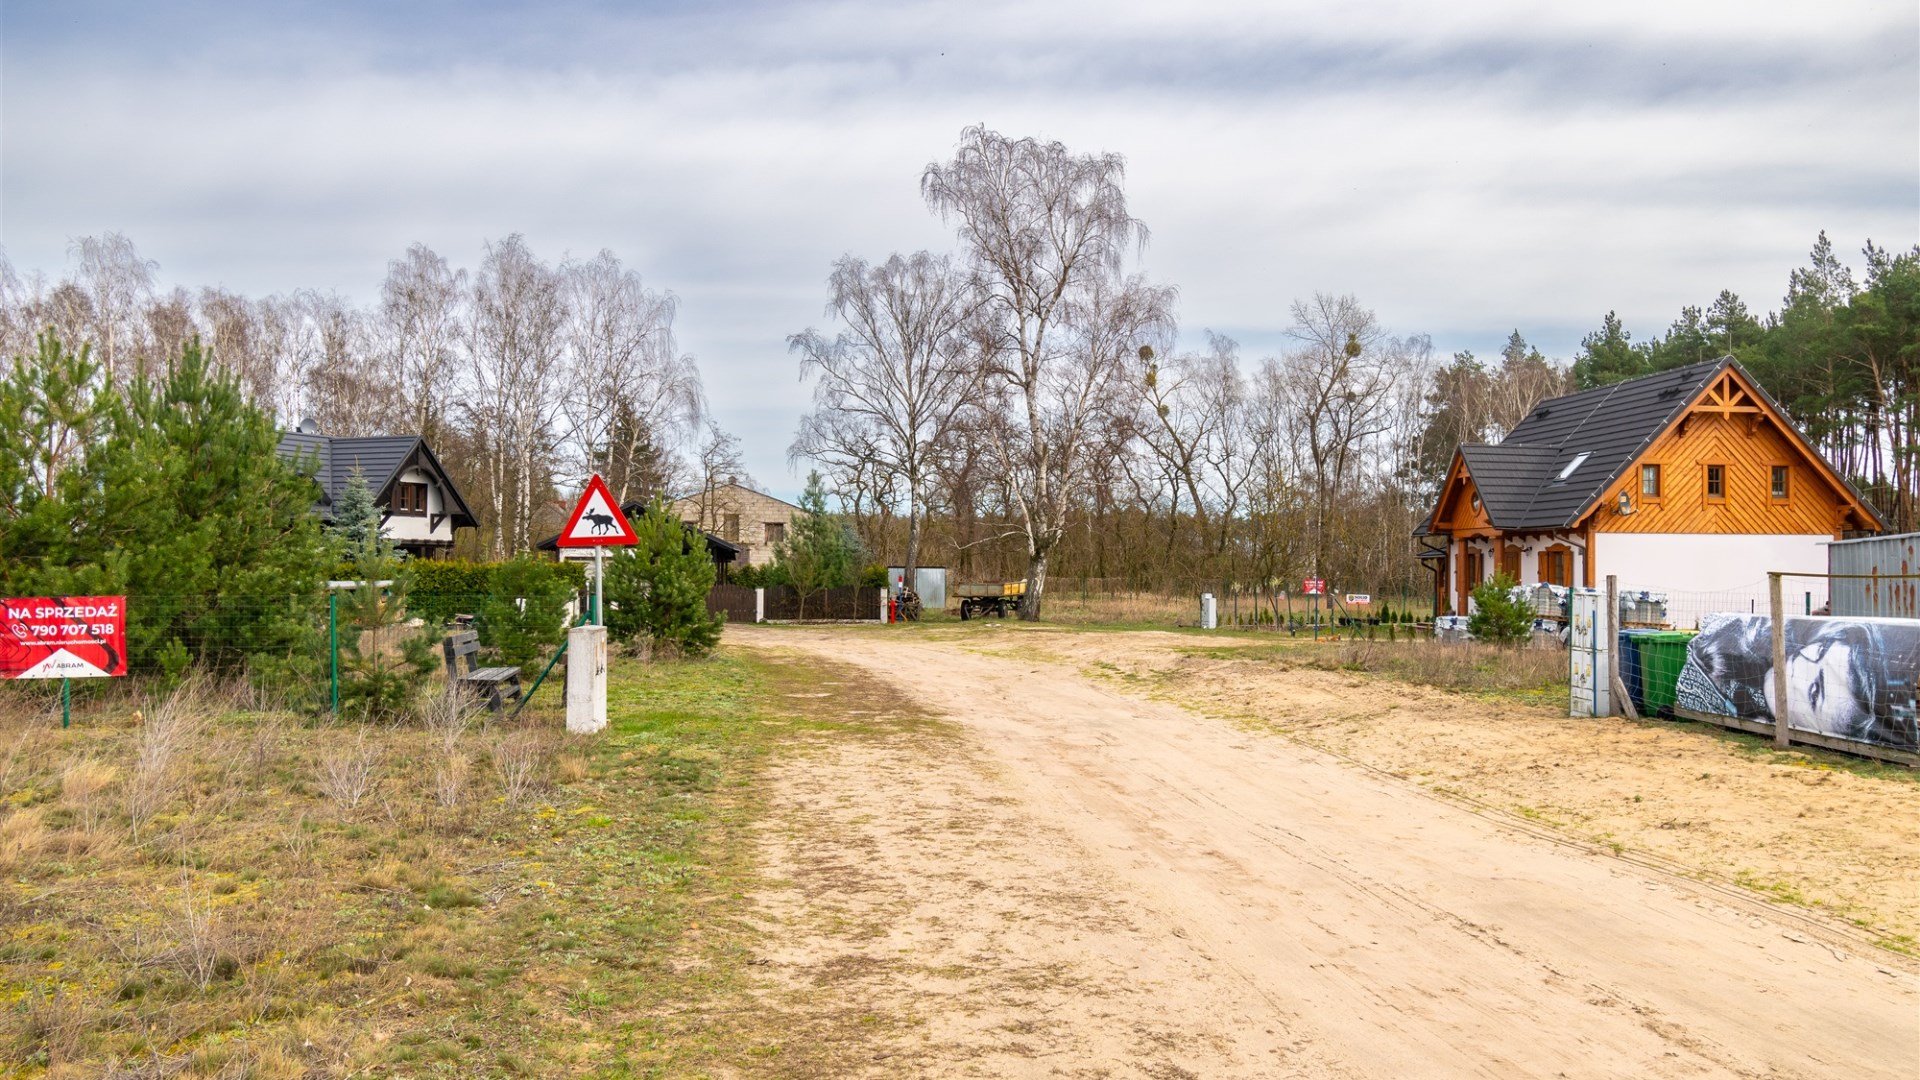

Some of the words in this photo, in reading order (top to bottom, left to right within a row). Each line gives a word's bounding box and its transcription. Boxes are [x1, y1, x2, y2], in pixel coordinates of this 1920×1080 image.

[8, 607, 32, 619] NA
[35, 603, 118, 619] SPRZEDAŻ
[31, 625, 57, 636] 790
[60, 624, 88, 635] 707
[91, 624, 114, 635] 518
